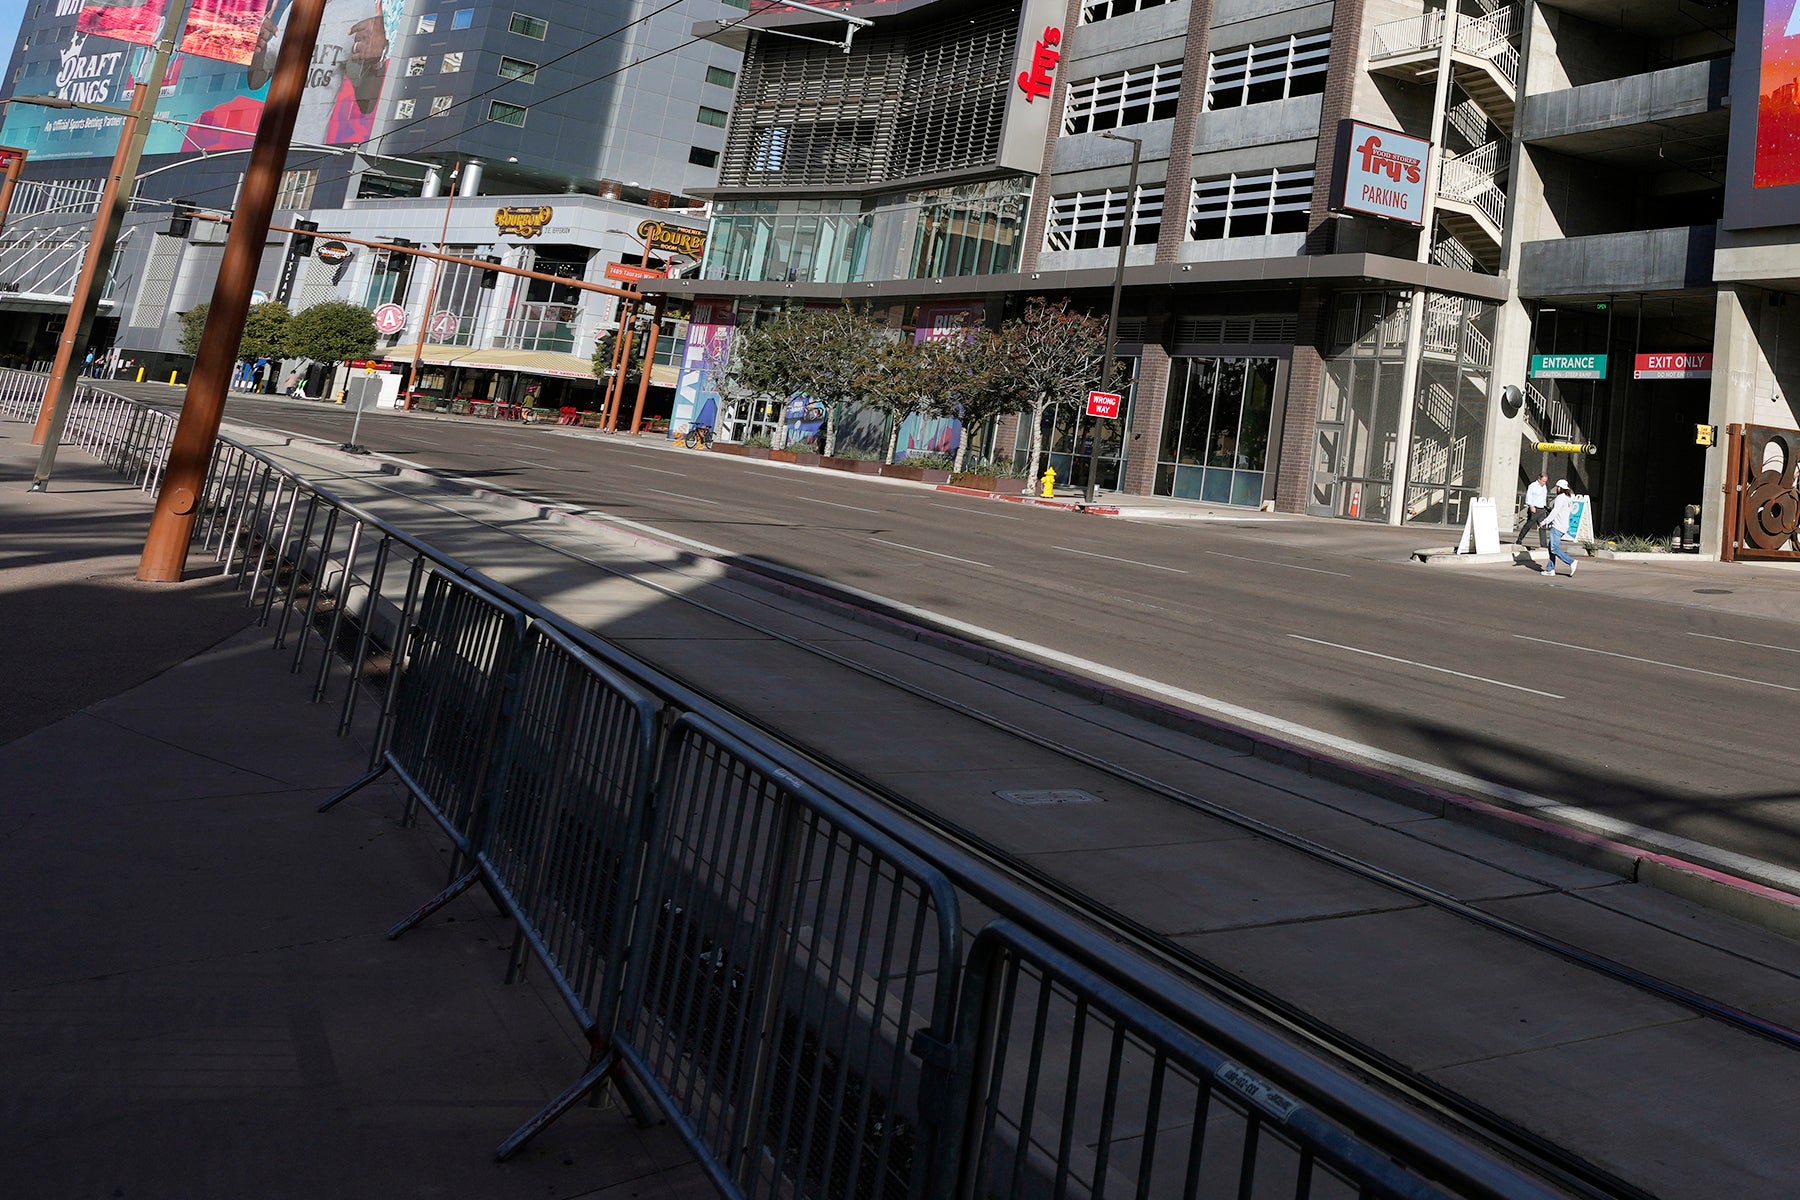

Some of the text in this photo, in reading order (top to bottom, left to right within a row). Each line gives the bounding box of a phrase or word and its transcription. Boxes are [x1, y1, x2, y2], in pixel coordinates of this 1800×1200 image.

[312, 44, 344, 66] AFT
[56, 52, 122, 87] DRAFT
[1017, 26, 1061, 104] fry's
[58, 79, 110, 104] KINGS
[44, 115, 121, 132] An Official Sports Betting Partner
[1357, 136, 1421, 183] fry's
[1373, 148, 1418, 164] FOOD STORES
[1362, 184, 1408, 210] PARKING
[383, 310, 396, 327] A
[690, 325, 708, 345] BOWL
[1542, 357, 1594, 369] ENTRANCE
[1648, 356, 1704, 369] EXIT ONLY
[1093, 396, 1116, 405] WRONG
[1096, 405, 1110, 413] WAY
